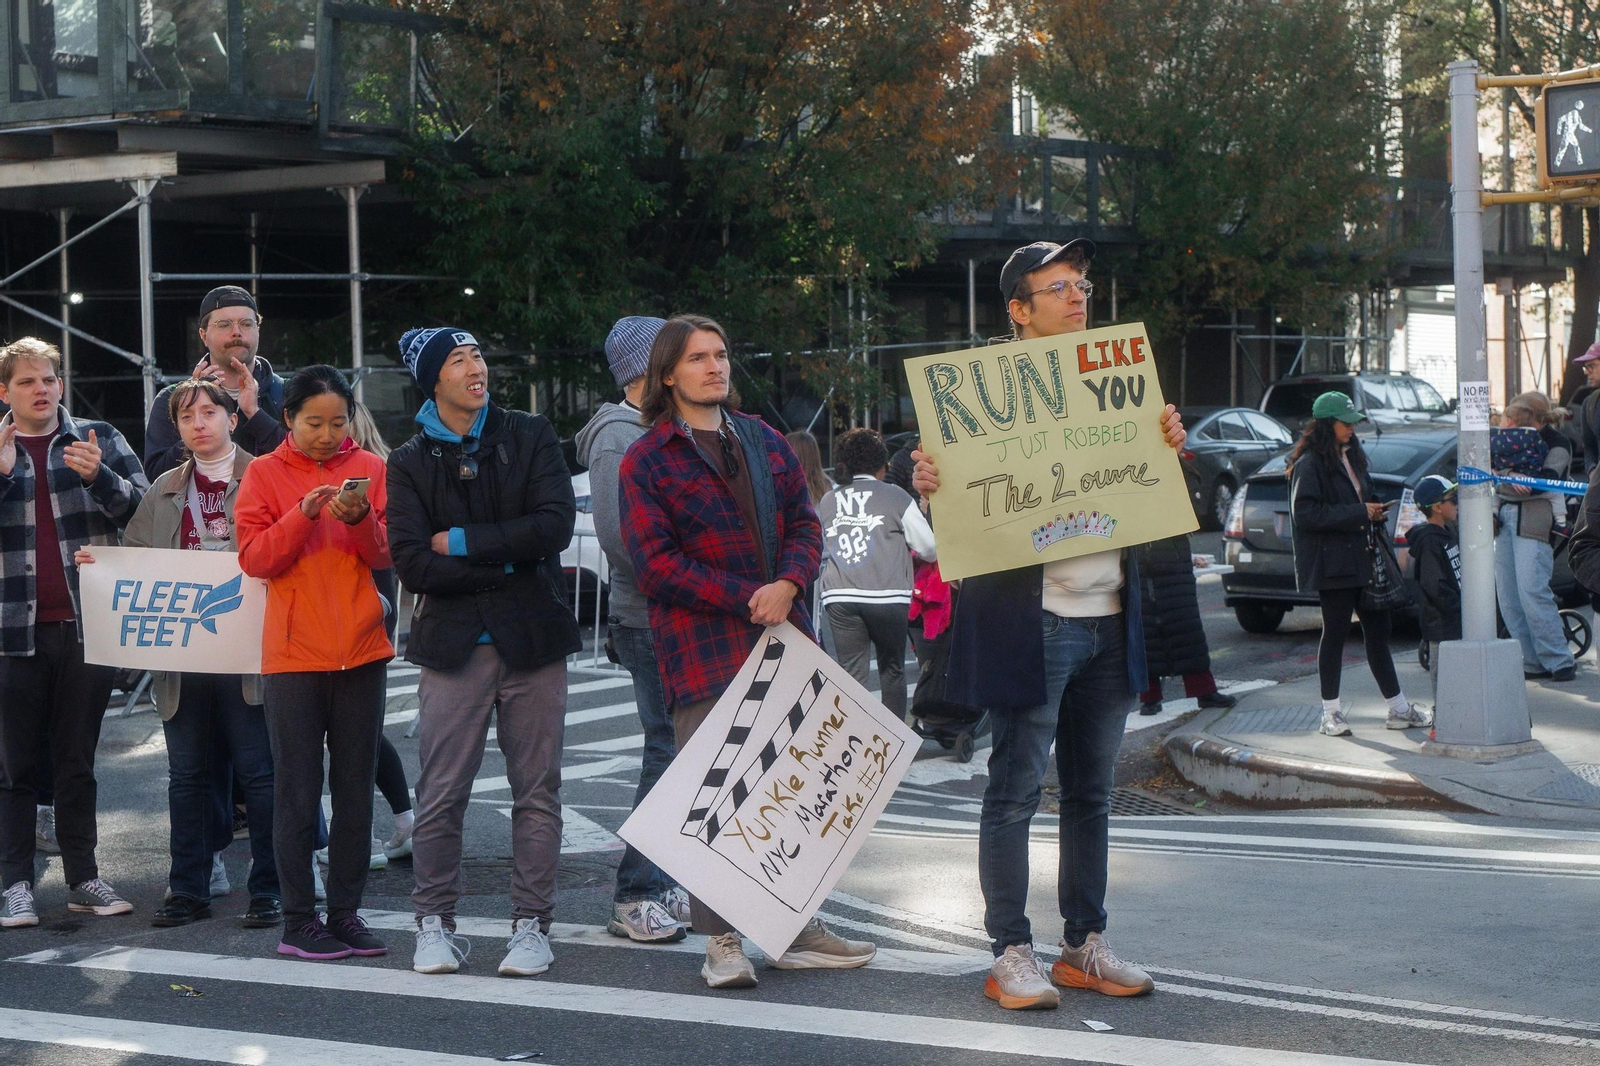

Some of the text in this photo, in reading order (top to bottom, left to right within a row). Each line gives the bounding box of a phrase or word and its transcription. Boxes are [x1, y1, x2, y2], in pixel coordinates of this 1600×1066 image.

[1076, 336, 1146, 374] LIKE
[923, 349, 1068, 447] RUN
[1082, 374, 1146, 411] YOU
[1463, 386, 1477, 396] NO
[986, 421, 1138, 462] JUST ROBBED
[834, 487, 873, 518] NY
[966, 473, 1042, 517] The
[838, 526, 868, 559] 92
[112, 579, 213, 614] FLEET
[120, 615, 200, 647] FEET
[789, 695, 849, 769] Runner
[856, 733, 892, 791] #32
[759, 735, 864, 884] NYC Marathon
